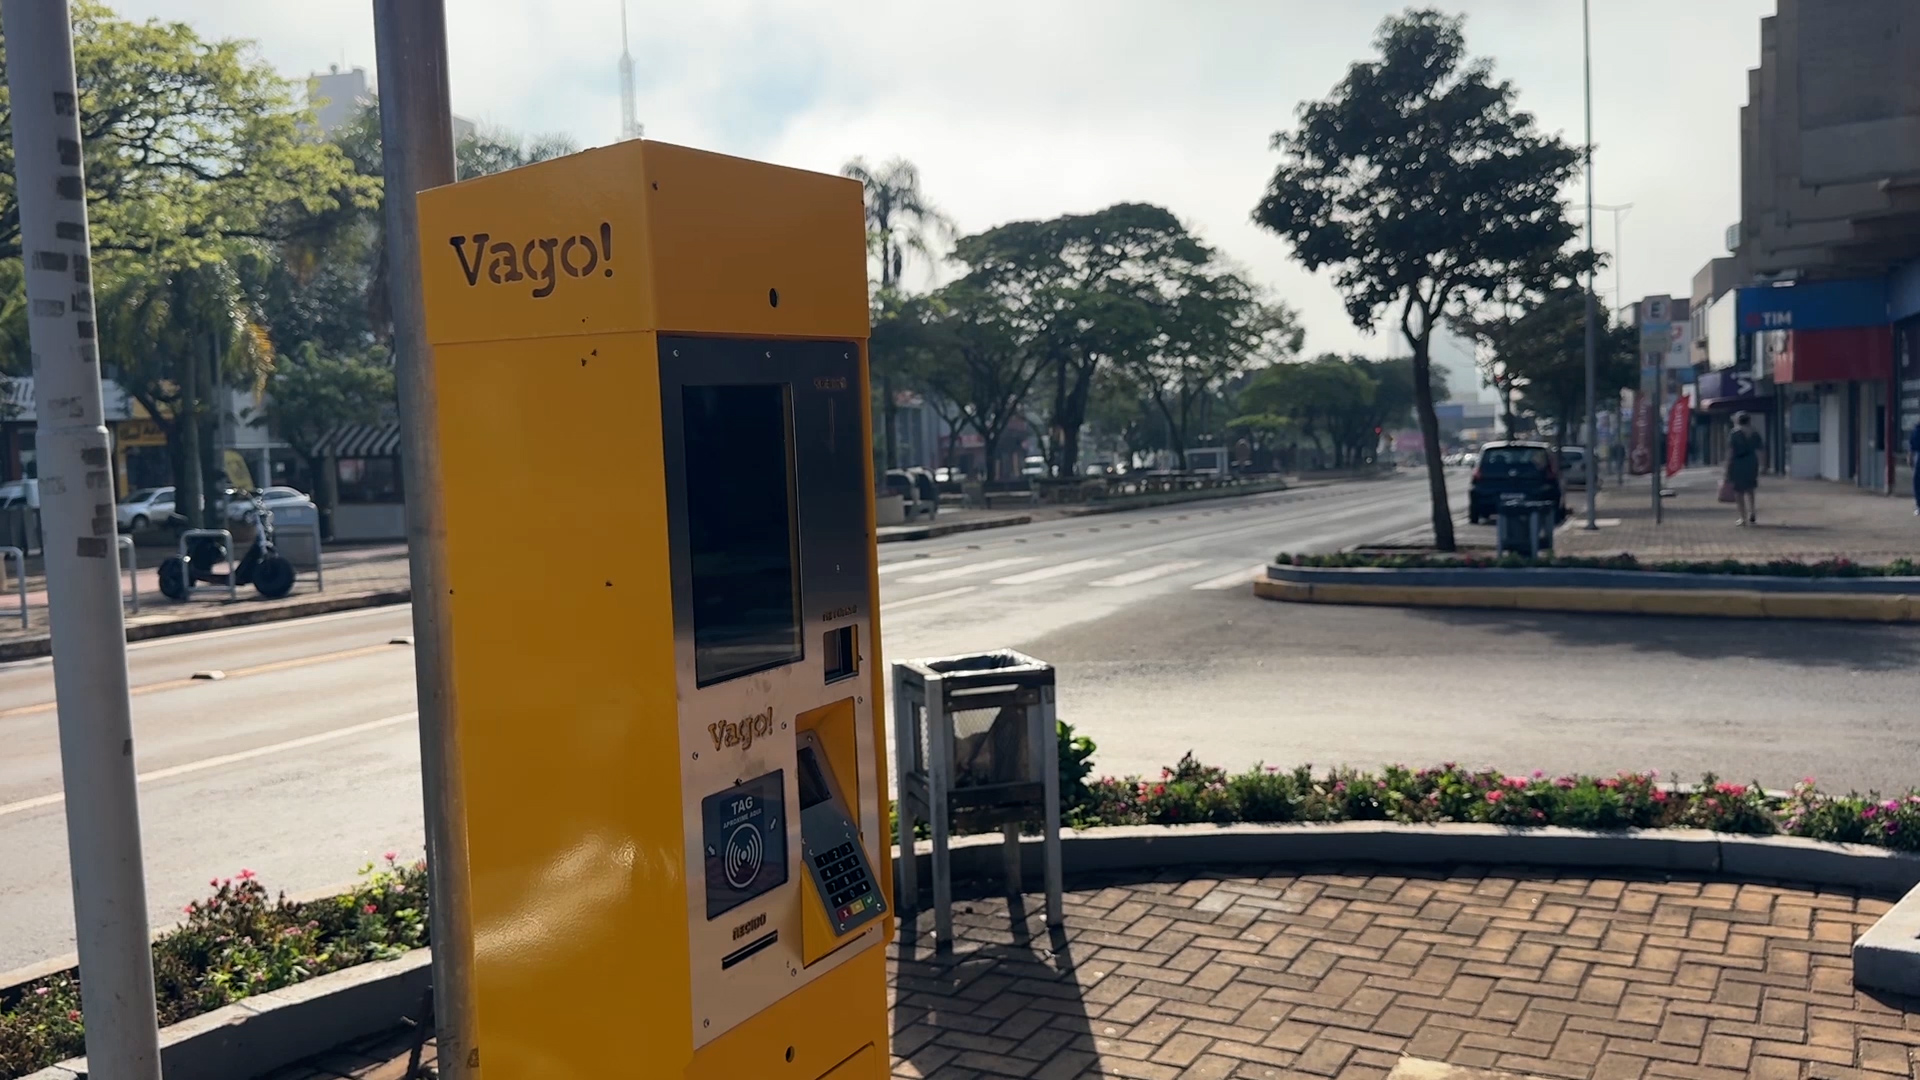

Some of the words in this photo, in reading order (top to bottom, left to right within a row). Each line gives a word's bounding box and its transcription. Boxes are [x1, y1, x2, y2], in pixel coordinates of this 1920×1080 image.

[449, 221, 613, 298] Vago!
[1762, 311, 1792, 327] TIM
[707, 706, 773, 751] Vago!
[731, 796, 754, 816] TAG
[723, 813, 749, 829] APROXIME
[749, 808, 762, 818] AQUI
